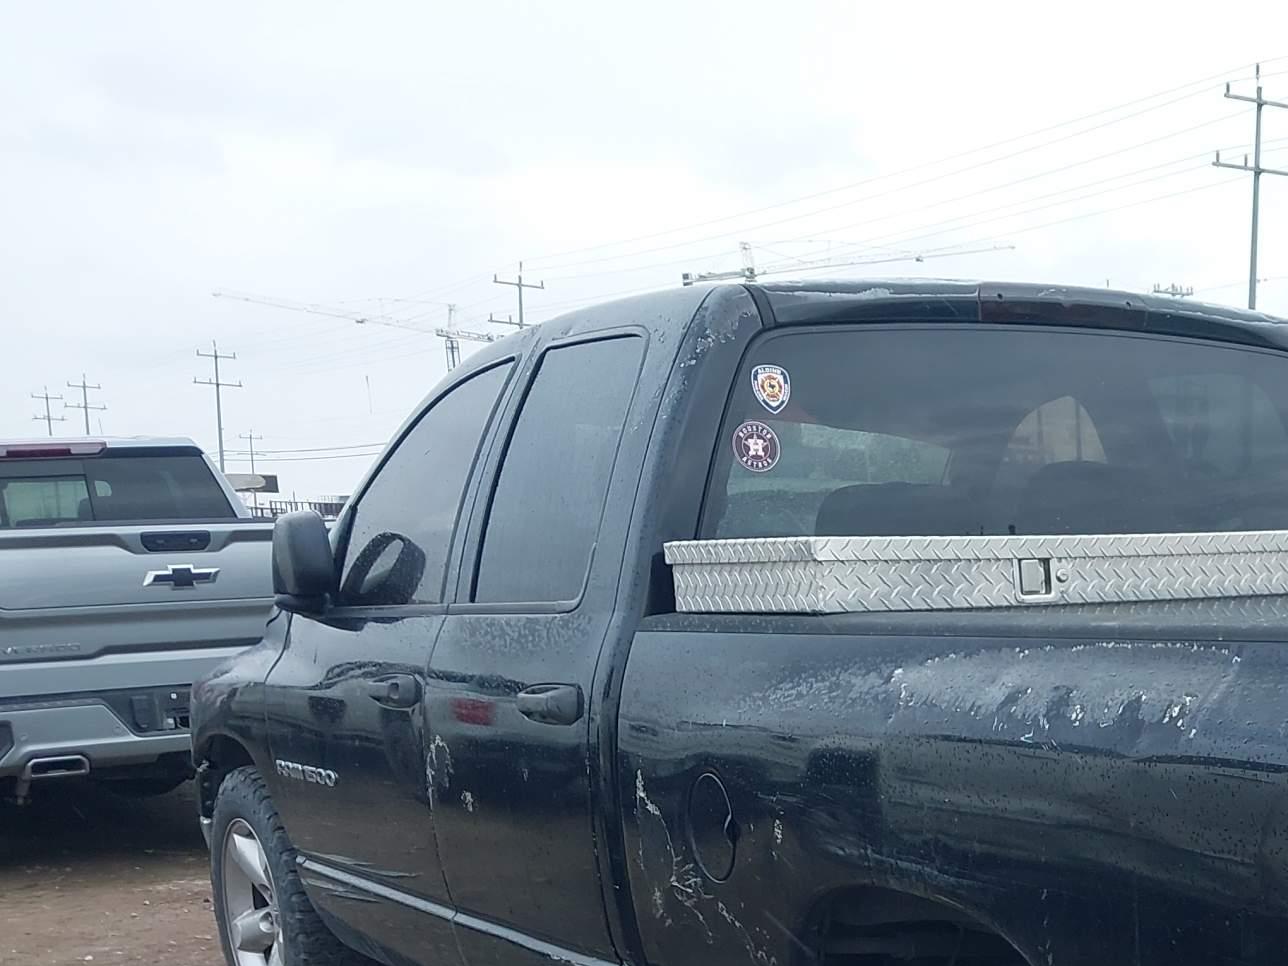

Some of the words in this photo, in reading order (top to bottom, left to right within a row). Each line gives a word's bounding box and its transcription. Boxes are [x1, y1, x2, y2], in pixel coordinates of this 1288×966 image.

[738, 425, 772, 440] HOUSTON
[741, 455, 773, 469] ASTROS
[275, 759, 303, 780] RAM
[303, 765, 336, 787] 1500
